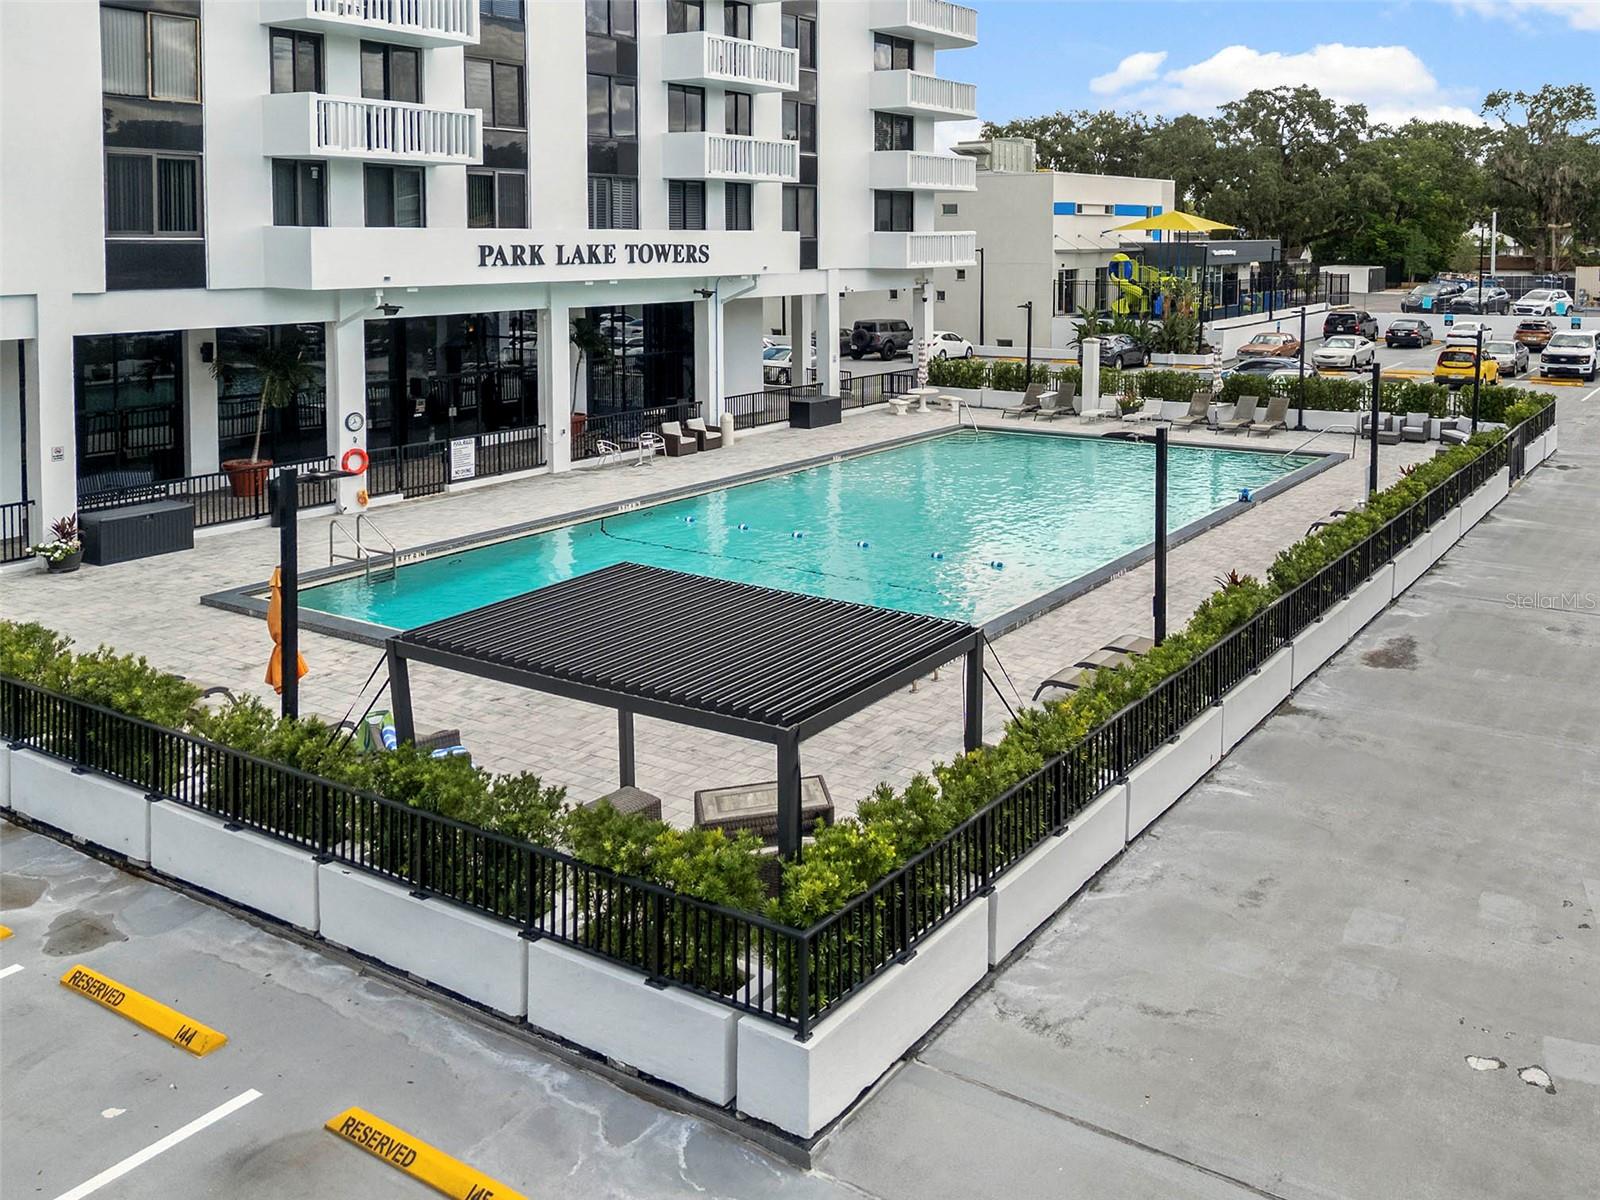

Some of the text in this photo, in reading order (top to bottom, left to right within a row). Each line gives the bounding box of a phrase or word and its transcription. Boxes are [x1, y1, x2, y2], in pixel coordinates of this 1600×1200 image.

[478, 243, 710, 267] PARK LAKE TOWERS
[68, 969, 198, 1046] RESERVED 144
[339, 1115, 417, 1168] RESERVED
